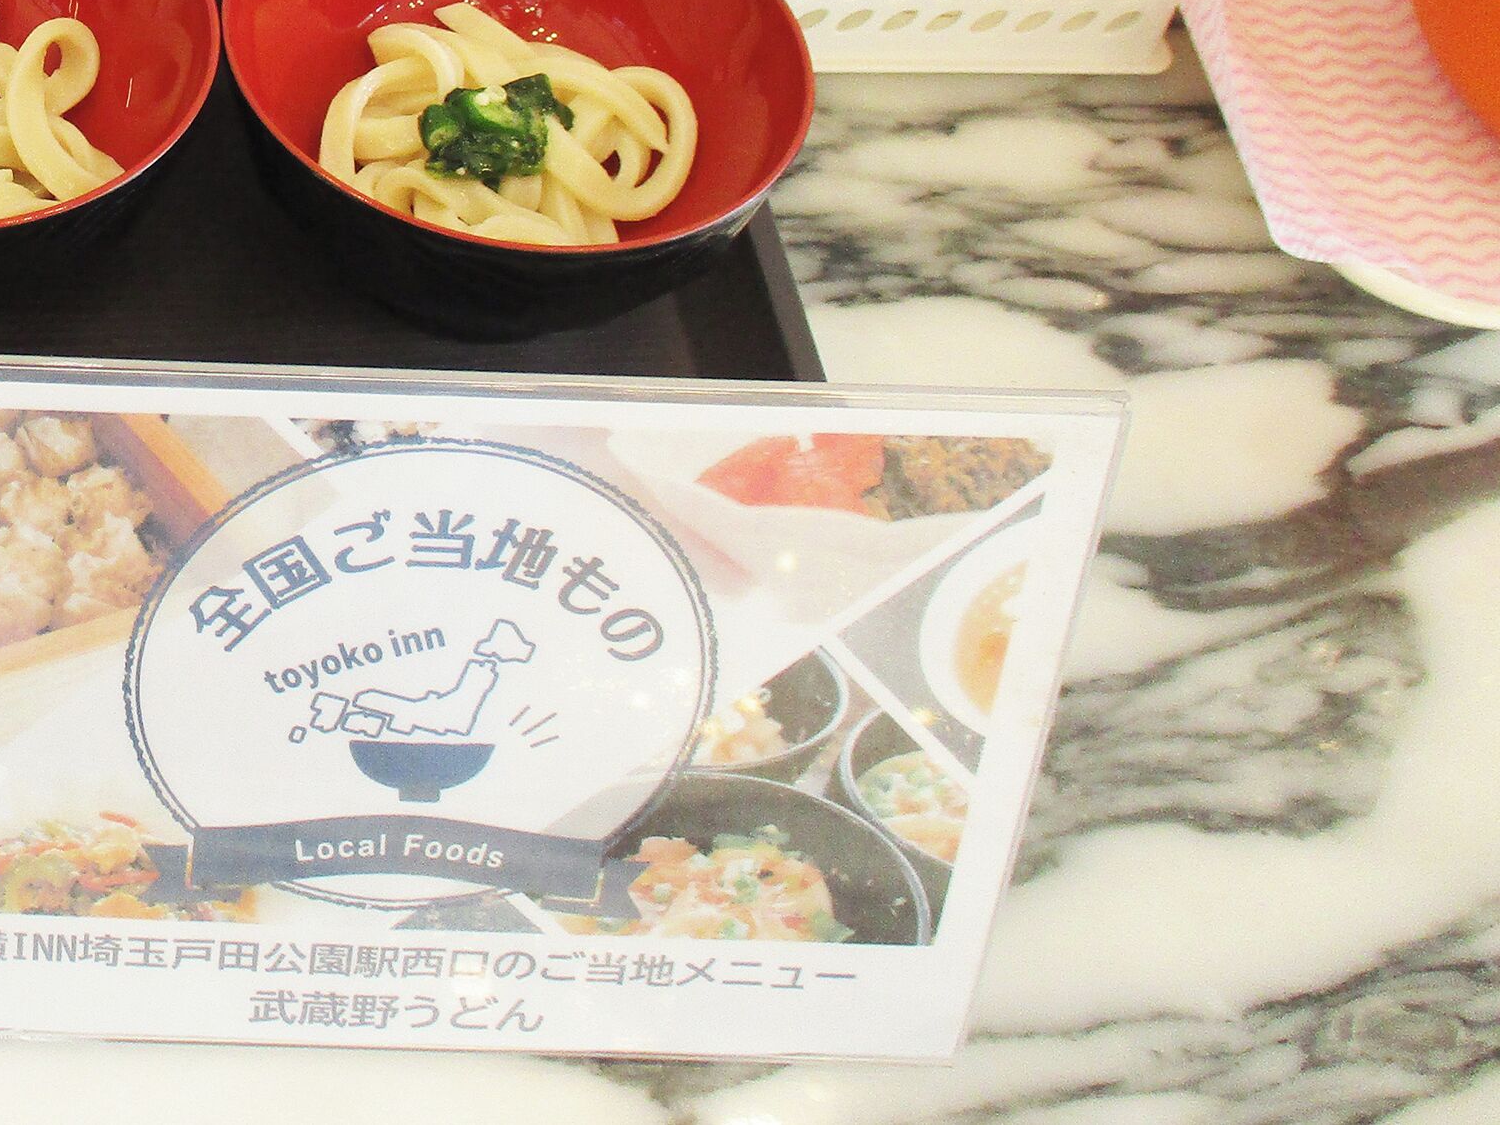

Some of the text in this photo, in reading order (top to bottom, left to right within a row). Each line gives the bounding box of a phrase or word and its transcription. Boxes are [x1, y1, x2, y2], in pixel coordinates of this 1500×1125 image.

[188, 508, 664, 661] 全国ご当地もの
[264, 624, 446, 694] toyoko inn
[295, 832, 504, 868] Local Foods
[248, 989, 543, 1034] 武蔵野うどん
